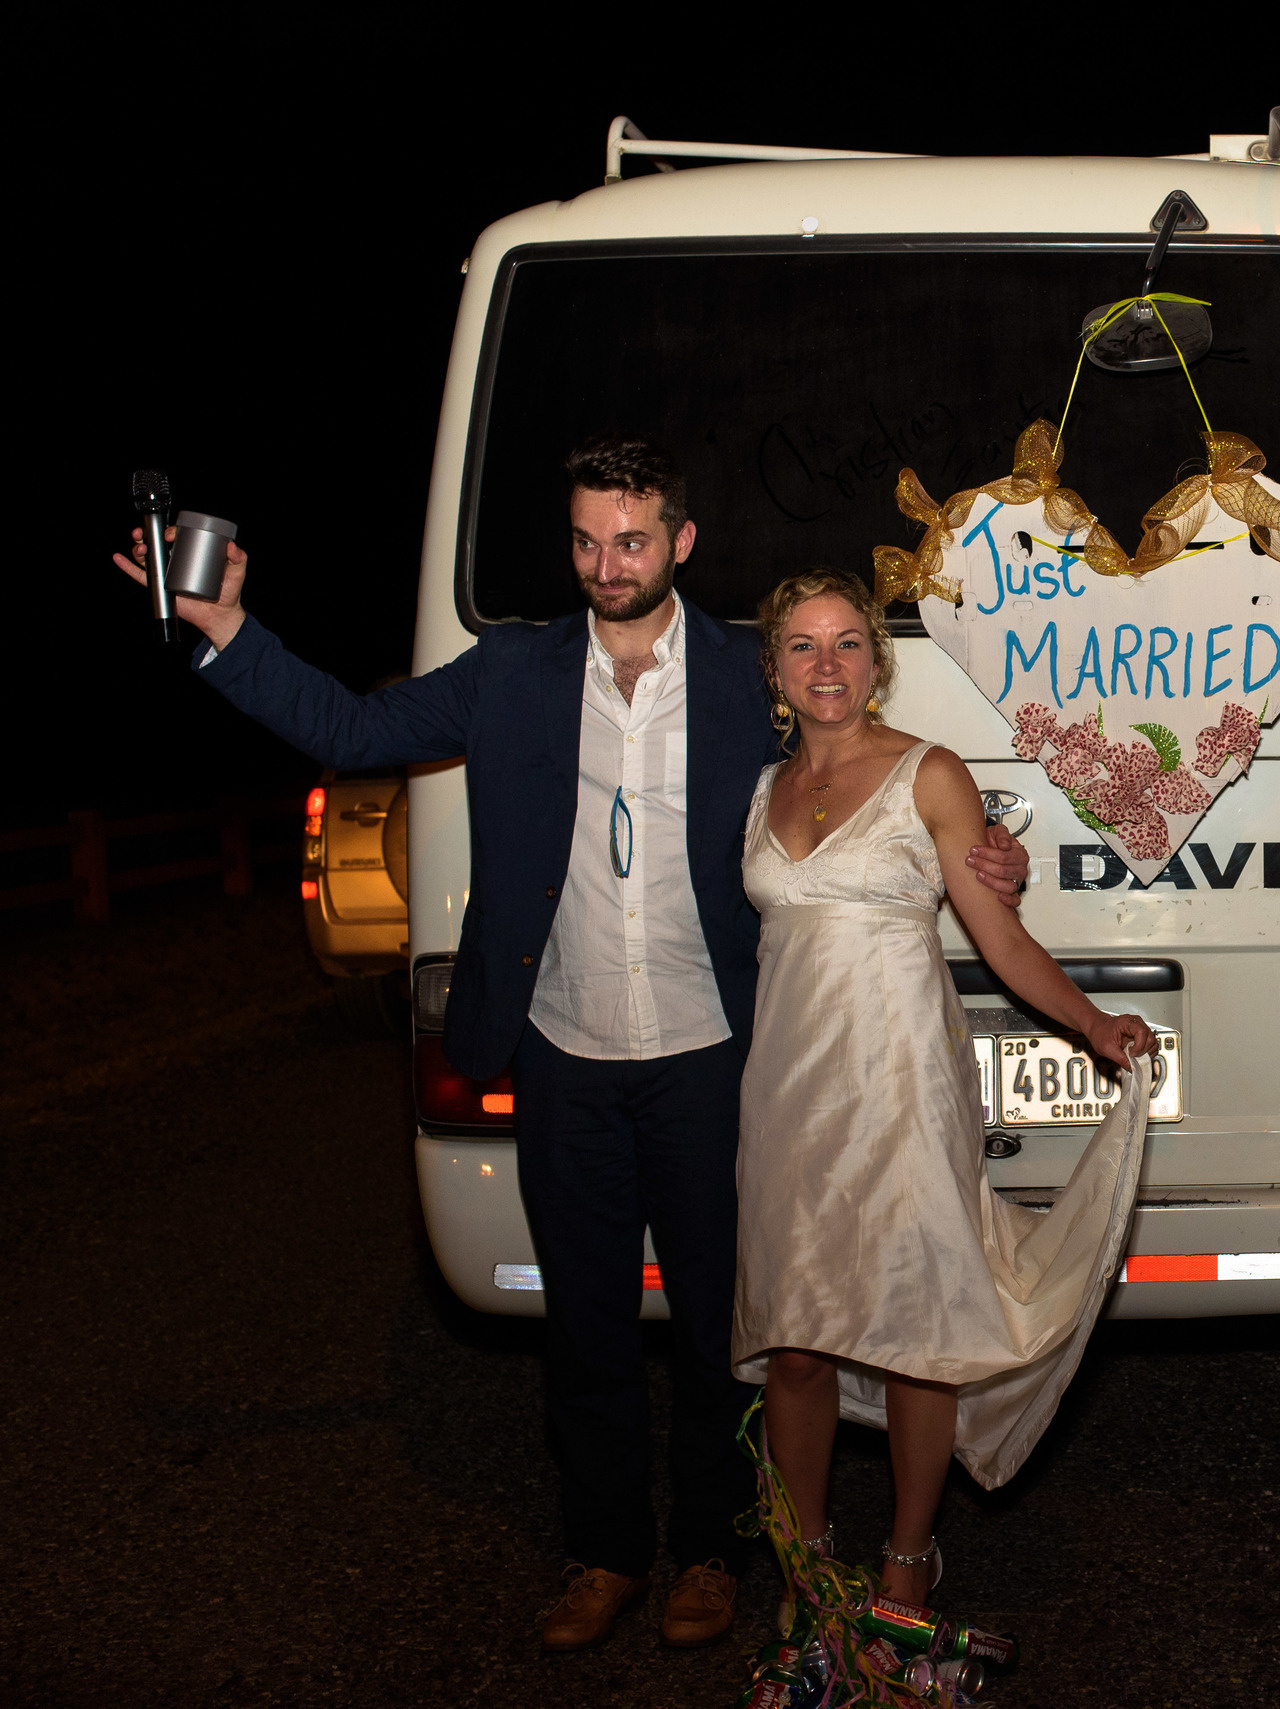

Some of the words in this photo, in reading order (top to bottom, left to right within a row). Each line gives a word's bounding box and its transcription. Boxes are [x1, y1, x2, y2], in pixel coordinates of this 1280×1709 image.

[962, 502, 1086, 614] Just
[1004, 1041, 1026, 1056] 20
[1013, 1054, 1168, 1102] 4B009
